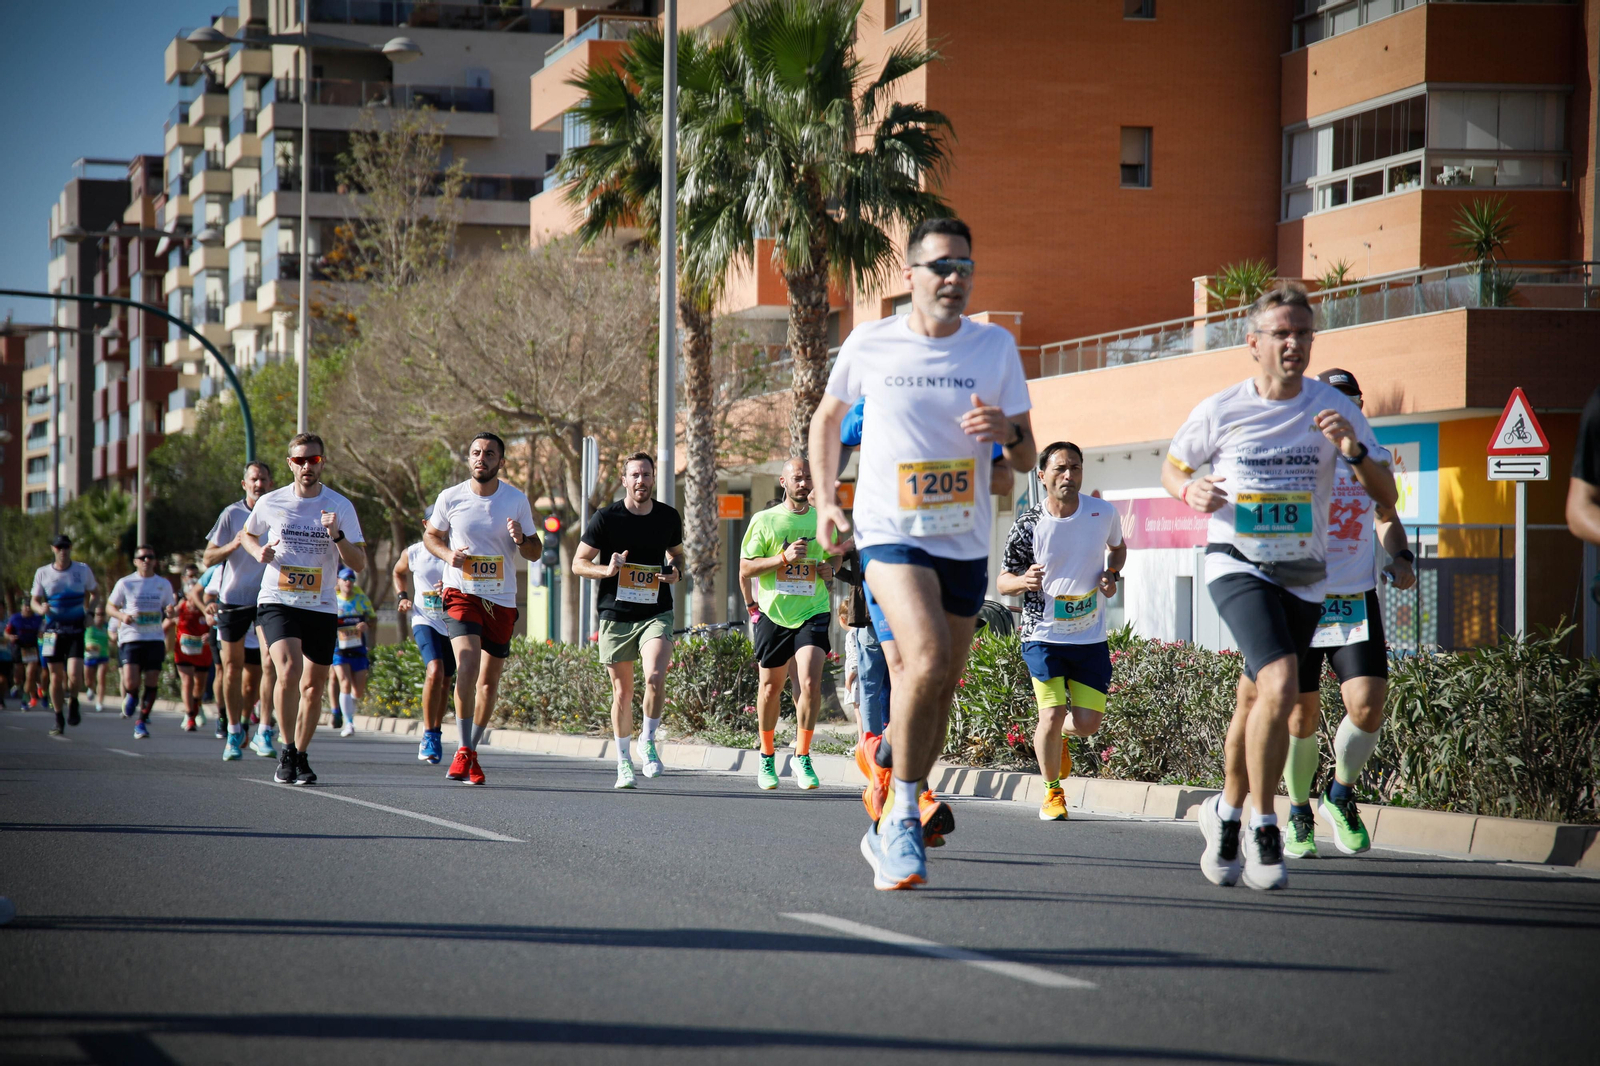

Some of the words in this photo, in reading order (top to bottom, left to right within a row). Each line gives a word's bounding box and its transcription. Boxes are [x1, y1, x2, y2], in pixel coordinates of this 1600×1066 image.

[885, 376, 975, 389] COSENTINO
[1236, 446, 1269, 455] Medio
[1273, 445, 1320, 455] Maratón
[1236, 455, 1283, 466] Almería
[1285, 454, 1320, 465] 2024
[906, 471, 968, 495] 1205
[923, 494, 953, 503] ALBERTO
[1250, 504, 1298, 524] 118
[1145, 517, 1156, 531] Centro
[281, 529, 310, 537] Almería
[310, 531, 330, 539] 2024
[471, 562, 497, 574] 109
[785, 563, 809, 576] 213
[288, 572, 315, 586] 570
[629, 571, 654, 584] 108
[1065, 597, 1093, 614] 644
